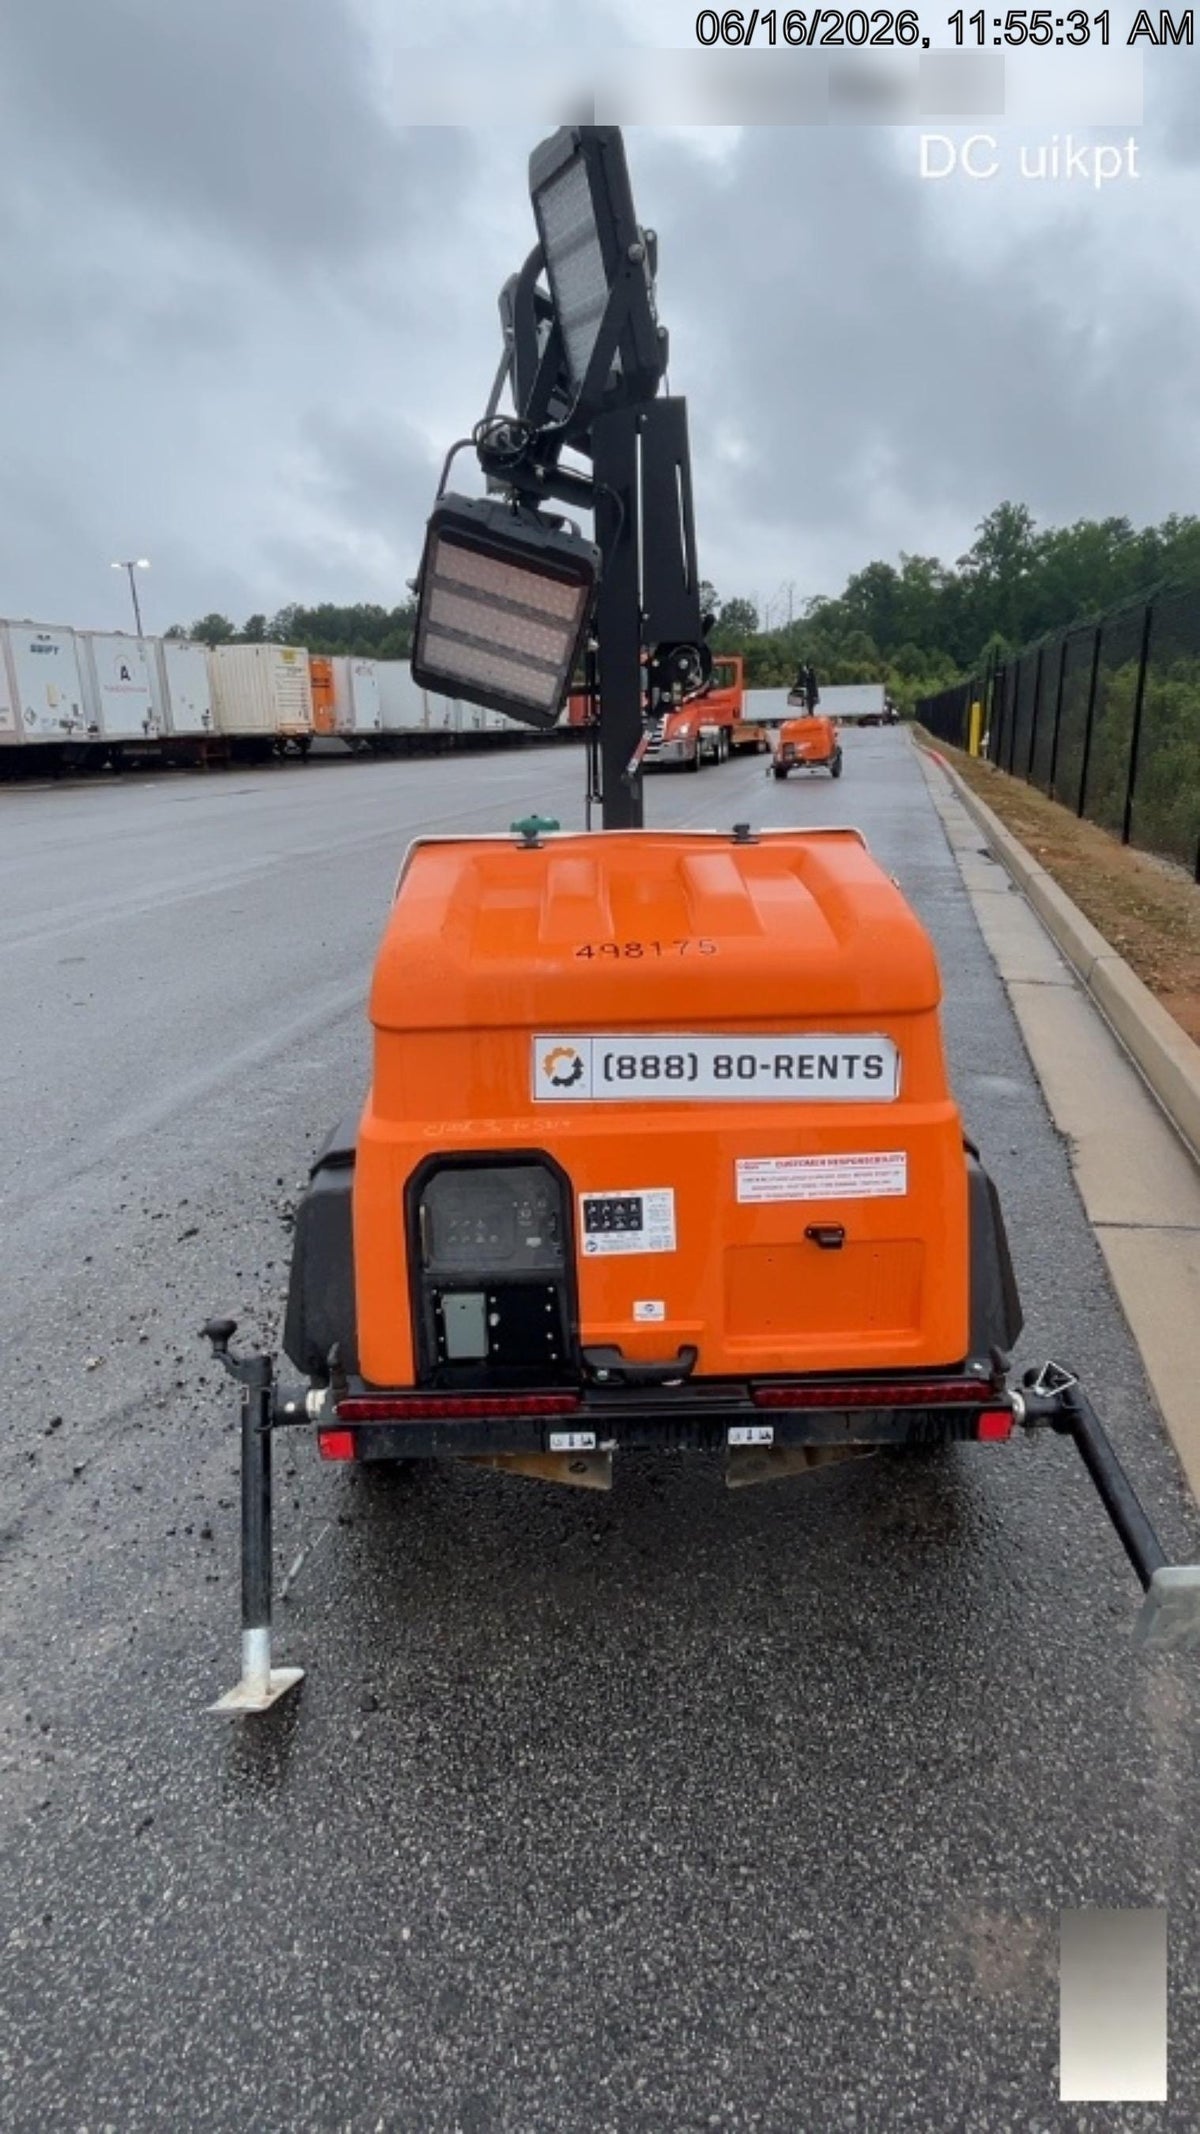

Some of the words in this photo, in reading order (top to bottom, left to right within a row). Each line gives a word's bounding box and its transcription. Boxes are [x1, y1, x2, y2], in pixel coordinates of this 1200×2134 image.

[575, 938, 717, 959] 498175
[603, 1053, 699, 1082] (888)
[712, 1053, 884, 1080] 80-RENTS
